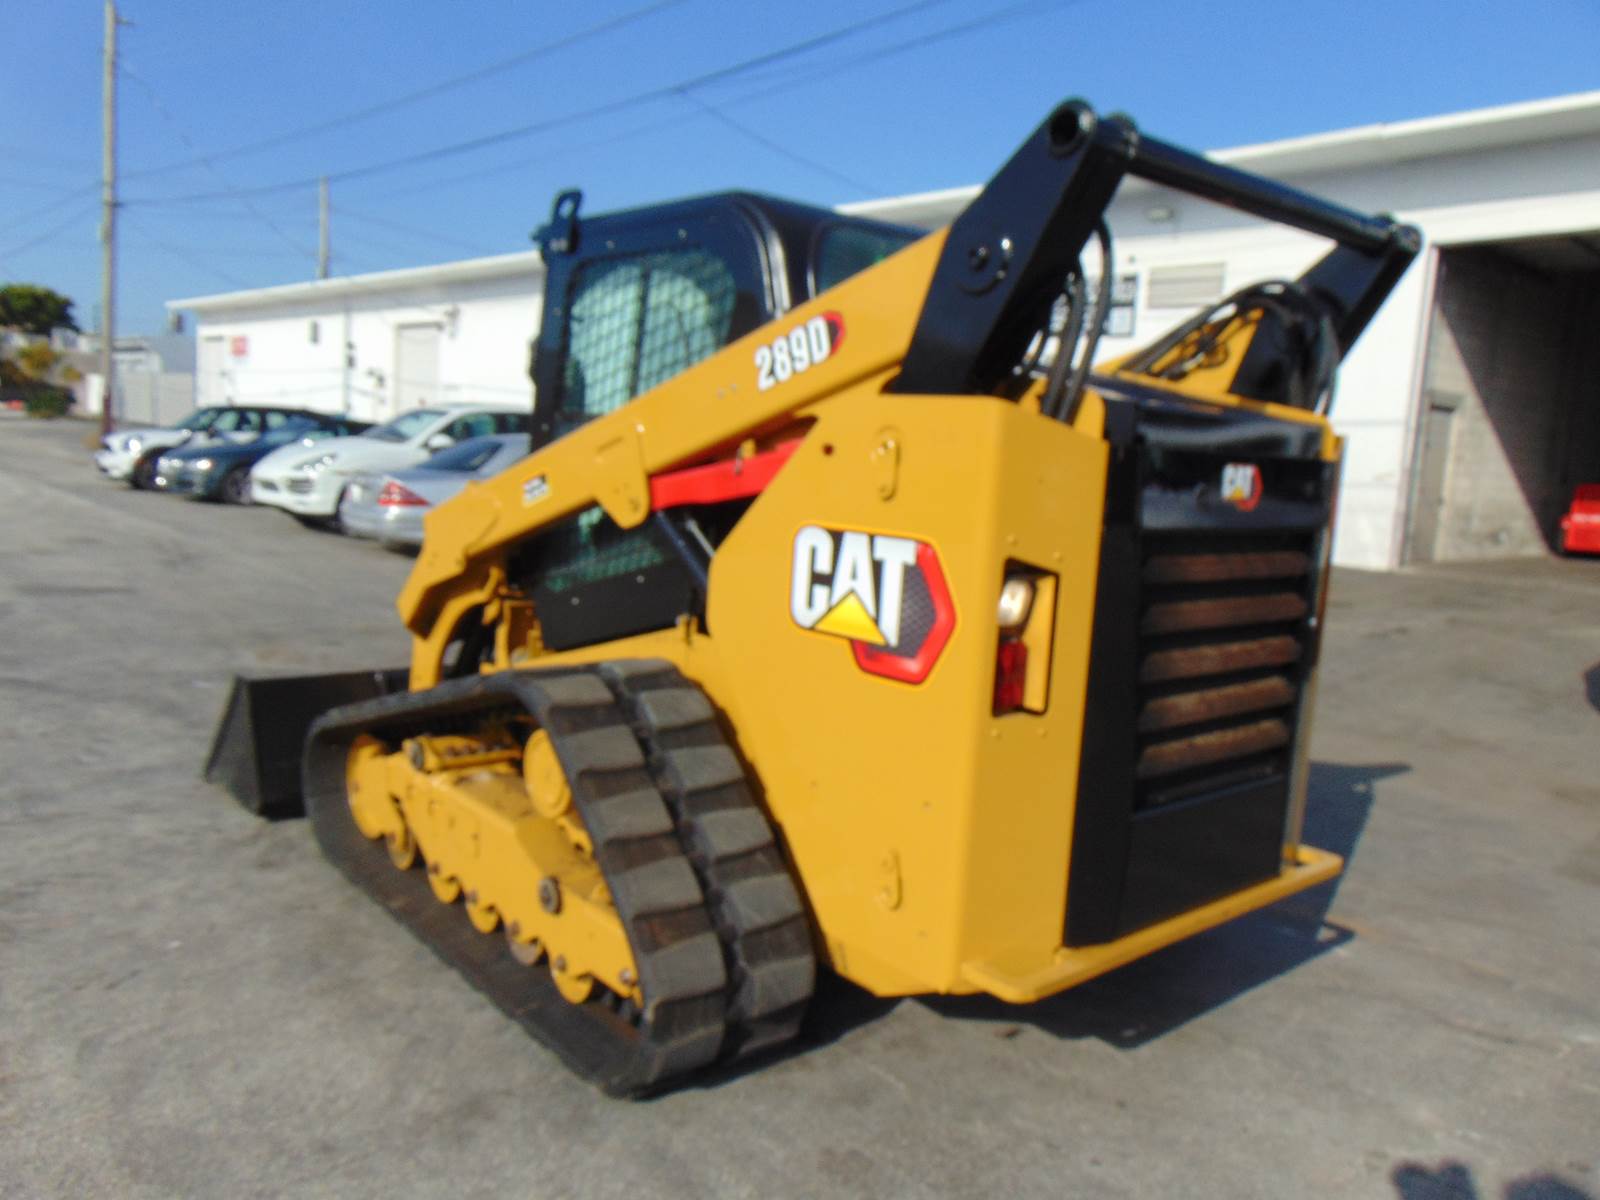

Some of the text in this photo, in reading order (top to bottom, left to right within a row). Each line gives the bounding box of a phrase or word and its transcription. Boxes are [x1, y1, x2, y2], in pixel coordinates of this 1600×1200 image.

[754, 316, 831, 391] 289D
[1221, 463, 1253, 500] CAT
[791, 525, 917, 647] CAT
